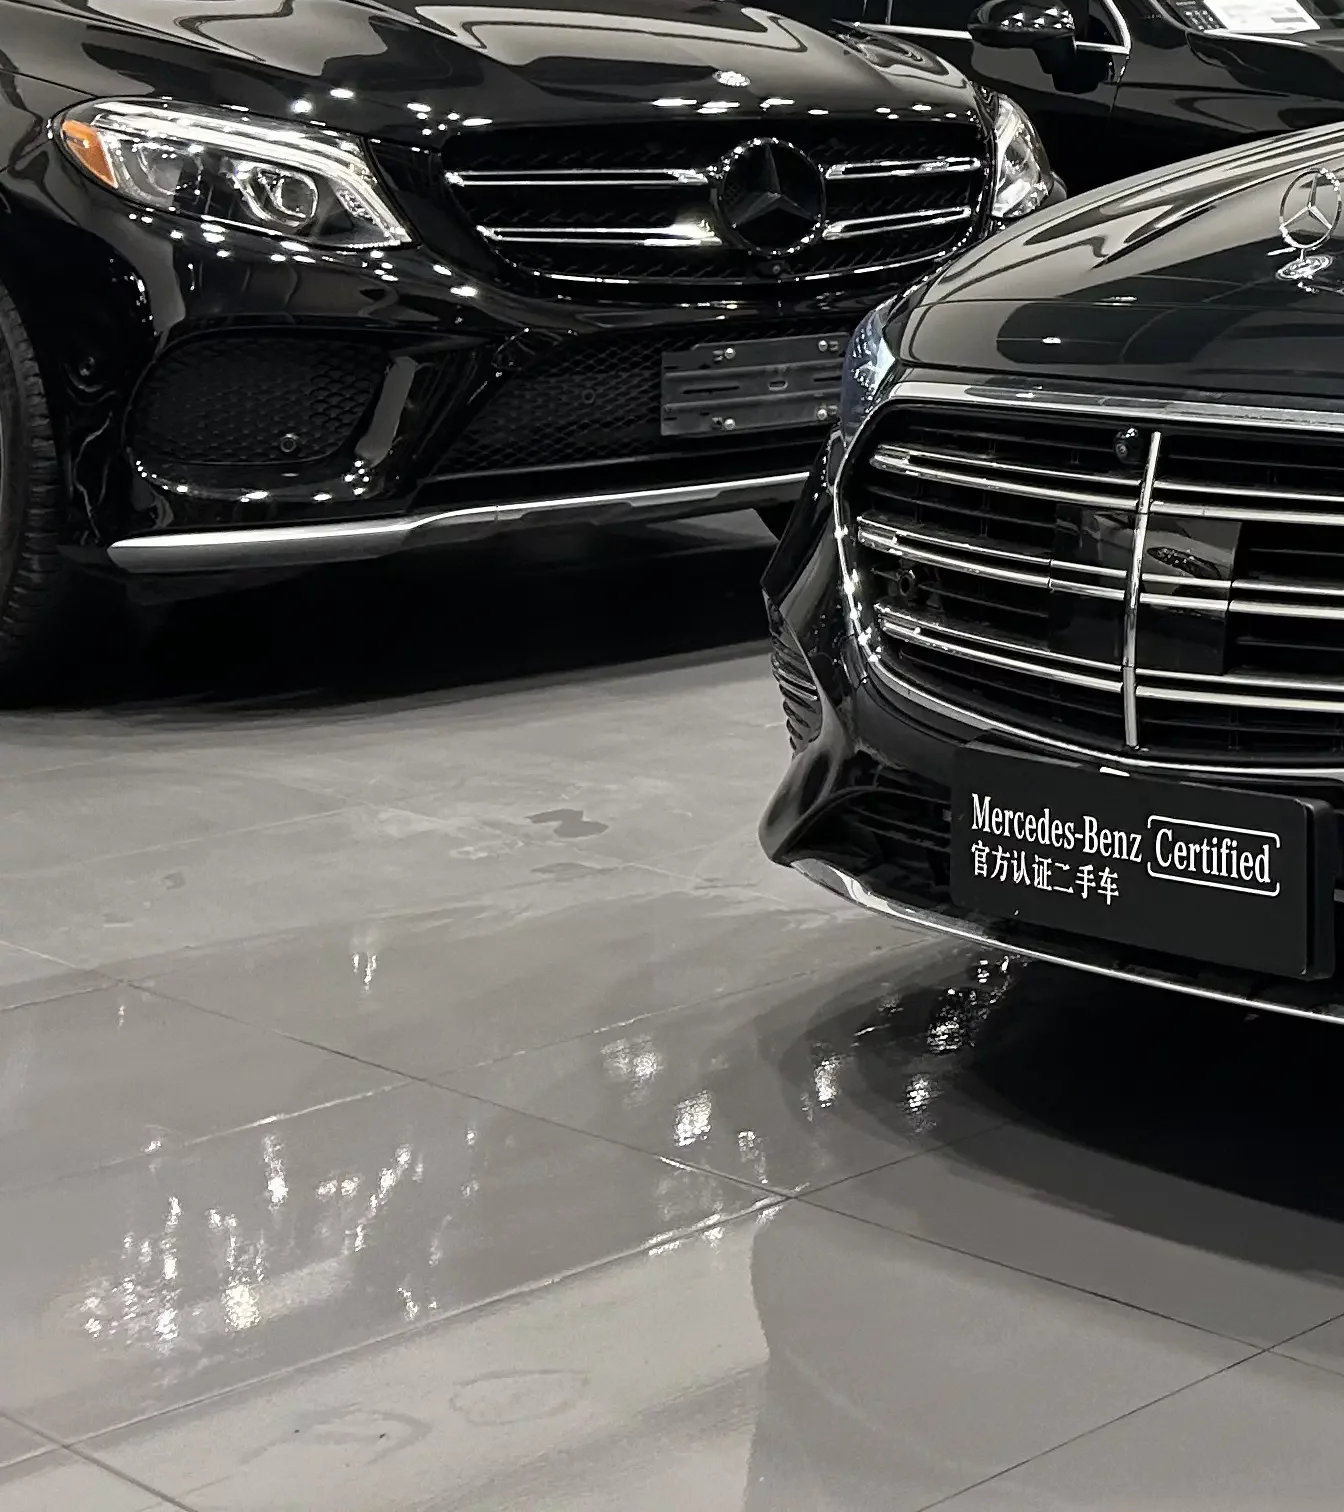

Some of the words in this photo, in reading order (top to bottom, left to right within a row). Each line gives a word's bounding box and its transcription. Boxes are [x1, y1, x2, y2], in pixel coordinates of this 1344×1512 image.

[971, 793, 1142, 863] Mercedes-Benz
[1155, 828, 1271, 884] Certified
[971, 840, 1119, 906] 官方认证二手车
